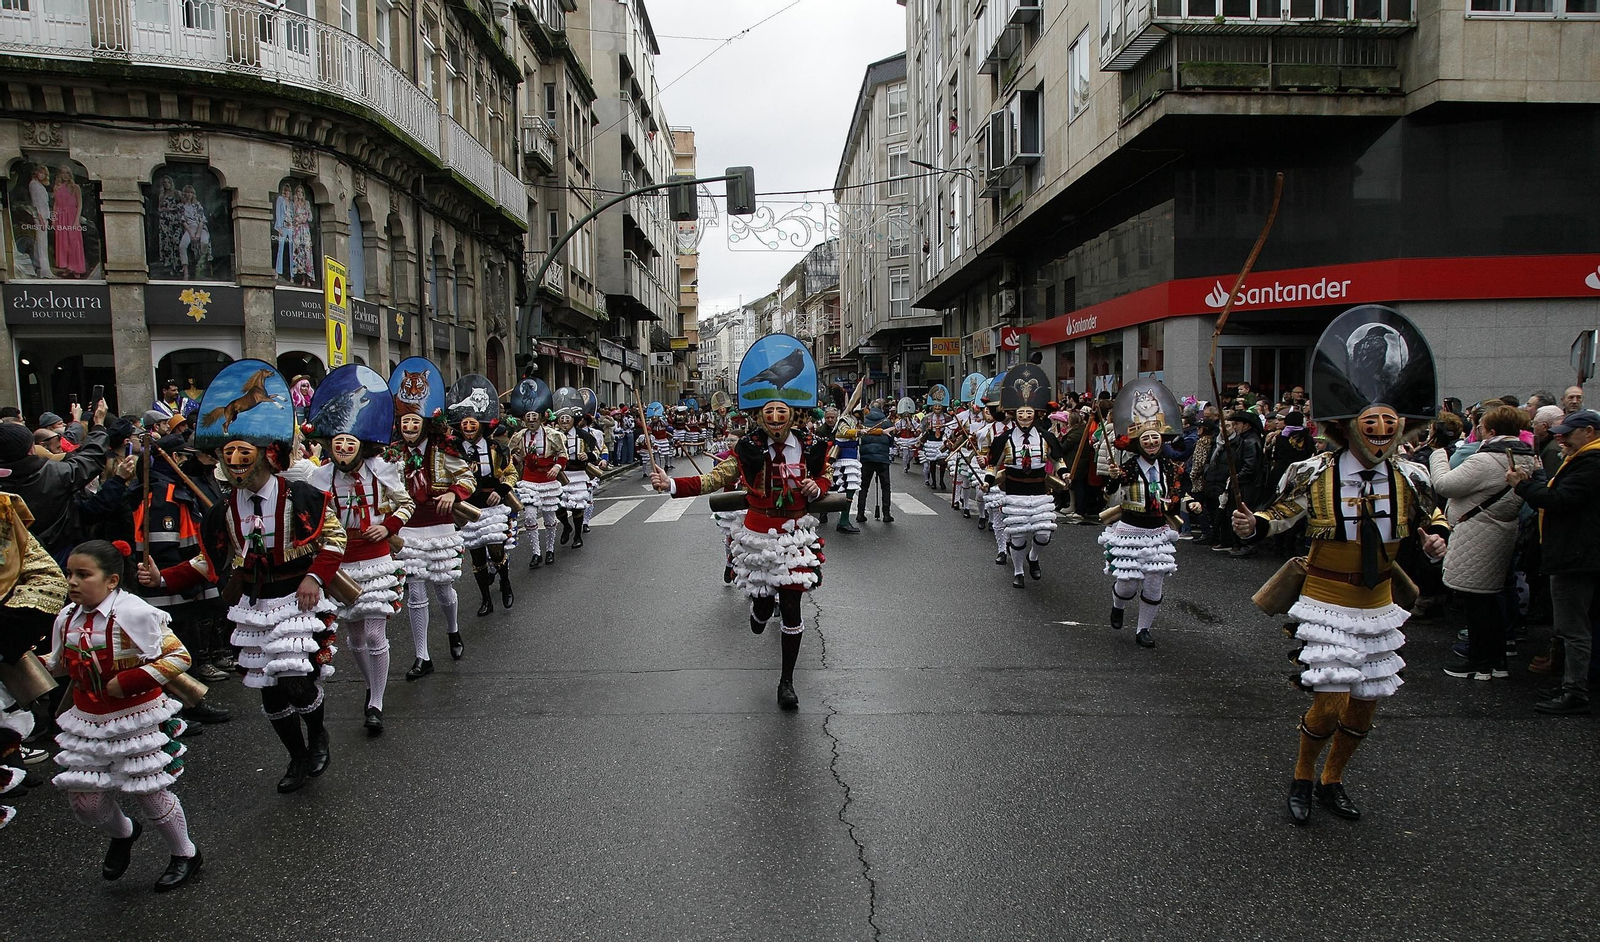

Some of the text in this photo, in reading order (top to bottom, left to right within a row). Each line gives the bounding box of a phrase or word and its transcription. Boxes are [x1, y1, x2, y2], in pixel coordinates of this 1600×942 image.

[21, 223, 88, 232] CRISTINA BARROS
[1233, 277, 1352, 306] Santander
[13, 290, 102, 309] abeloura
[301, 301, 322, 310] MODA
[32, 311, 86, 320] BOUTIQUE
[354, 305, 379, 325] abeloura
[1071, 313, 1098, 335] Santander
[932, 341, 960, 351] PONTE
